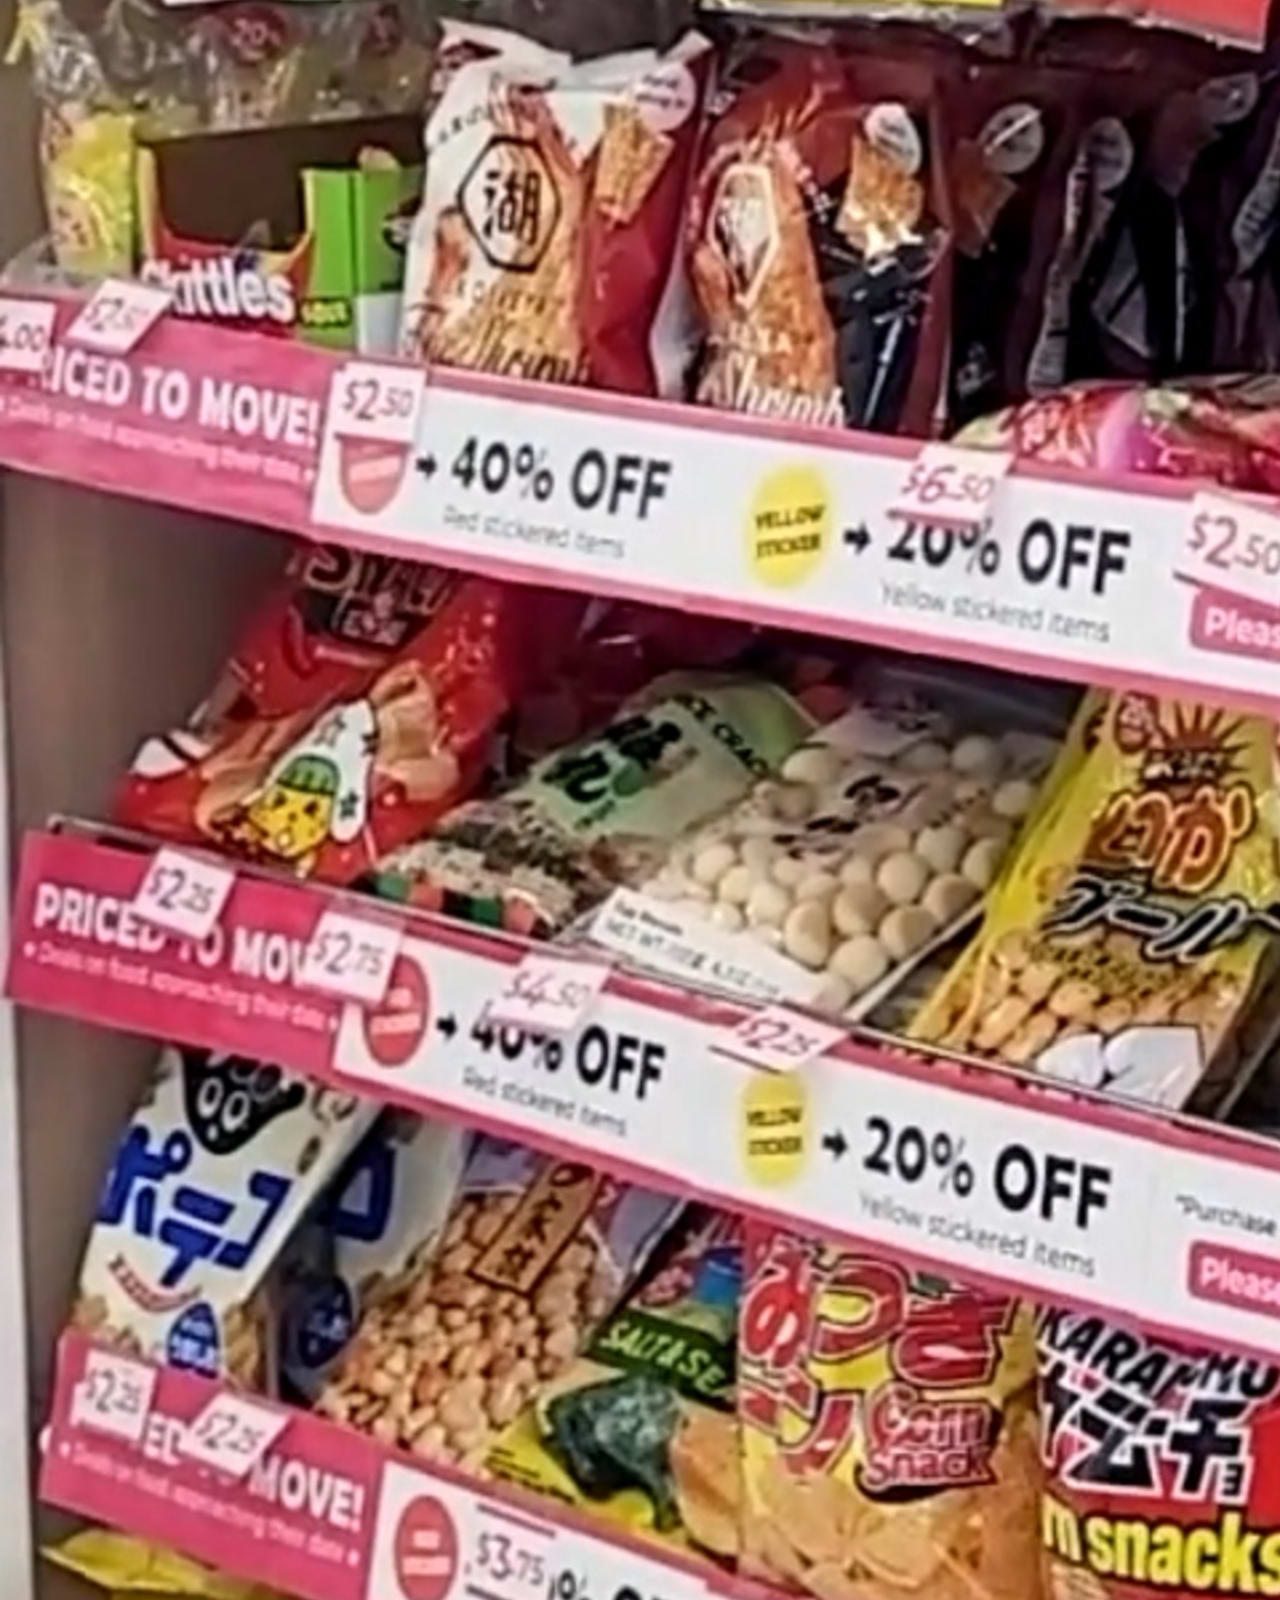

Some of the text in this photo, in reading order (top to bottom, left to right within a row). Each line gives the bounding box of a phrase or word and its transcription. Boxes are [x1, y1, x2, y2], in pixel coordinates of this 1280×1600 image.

[140, 255, 295, 323] Skittles
[143, 366, 187, 419] TO
[200, 374, 321, 446] MOVE!
[340, 378, 414, 422] $2.50
[451, 436, 671, 520] 40% OFF
[900, 463, 995, 507] $6.50
[443, 505, 479, 530] Red
[578, 529, 625, 561] items
[1018, 516, 1131, 596] OFF
[880, 580, 1110, 645] Yellow stickered items
[312, 932, 383, 977] $2.75
[576, 1025, 666, 1100] OFF
[863, 1115, 1113, 1230] 20% OFF
[860, 1190, 1096, 1280] Yellow stickered items
[249, 1462, 363, 1530] MOVE!
[475, 1533, 546, 1583] $3.75
